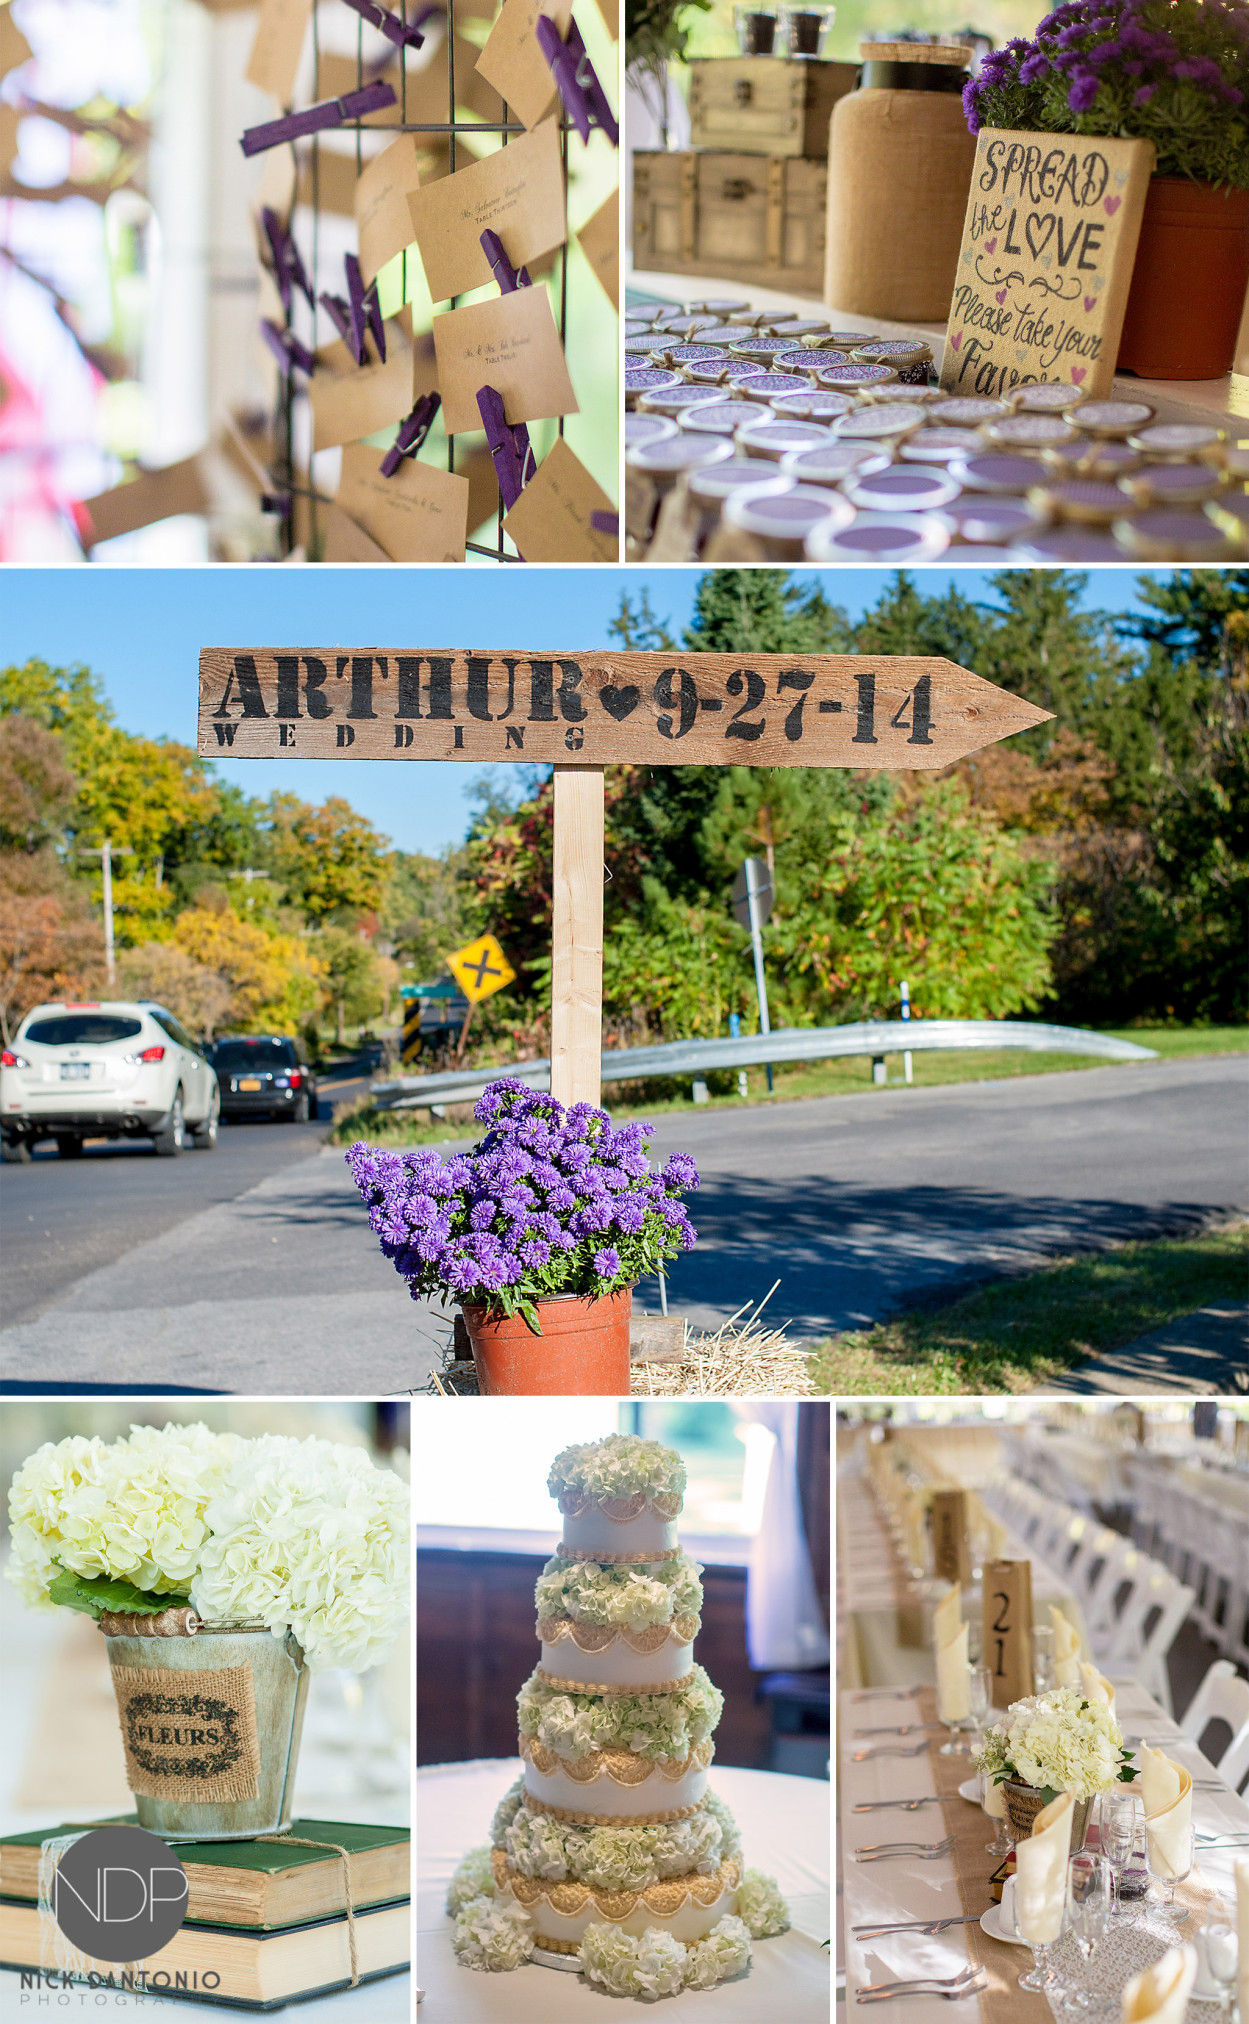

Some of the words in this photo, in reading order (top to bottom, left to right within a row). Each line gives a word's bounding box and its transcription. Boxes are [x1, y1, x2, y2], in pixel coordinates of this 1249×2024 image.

[980, 140, 1109, 208] SPREAD
[475, 212, 492, 224] TABLE
[970, 202, 1007, 240] the
[954, 284, 1013, 336] Please
[212, 655, 588, 723] ARTHUR
[654, 667, 936, 745] 9-27-14
[213, 722, 586, 750] WEDDING
[993, 1591, 1010, 1677] 21
[138, 1725, 220, 1746] FLEURS
